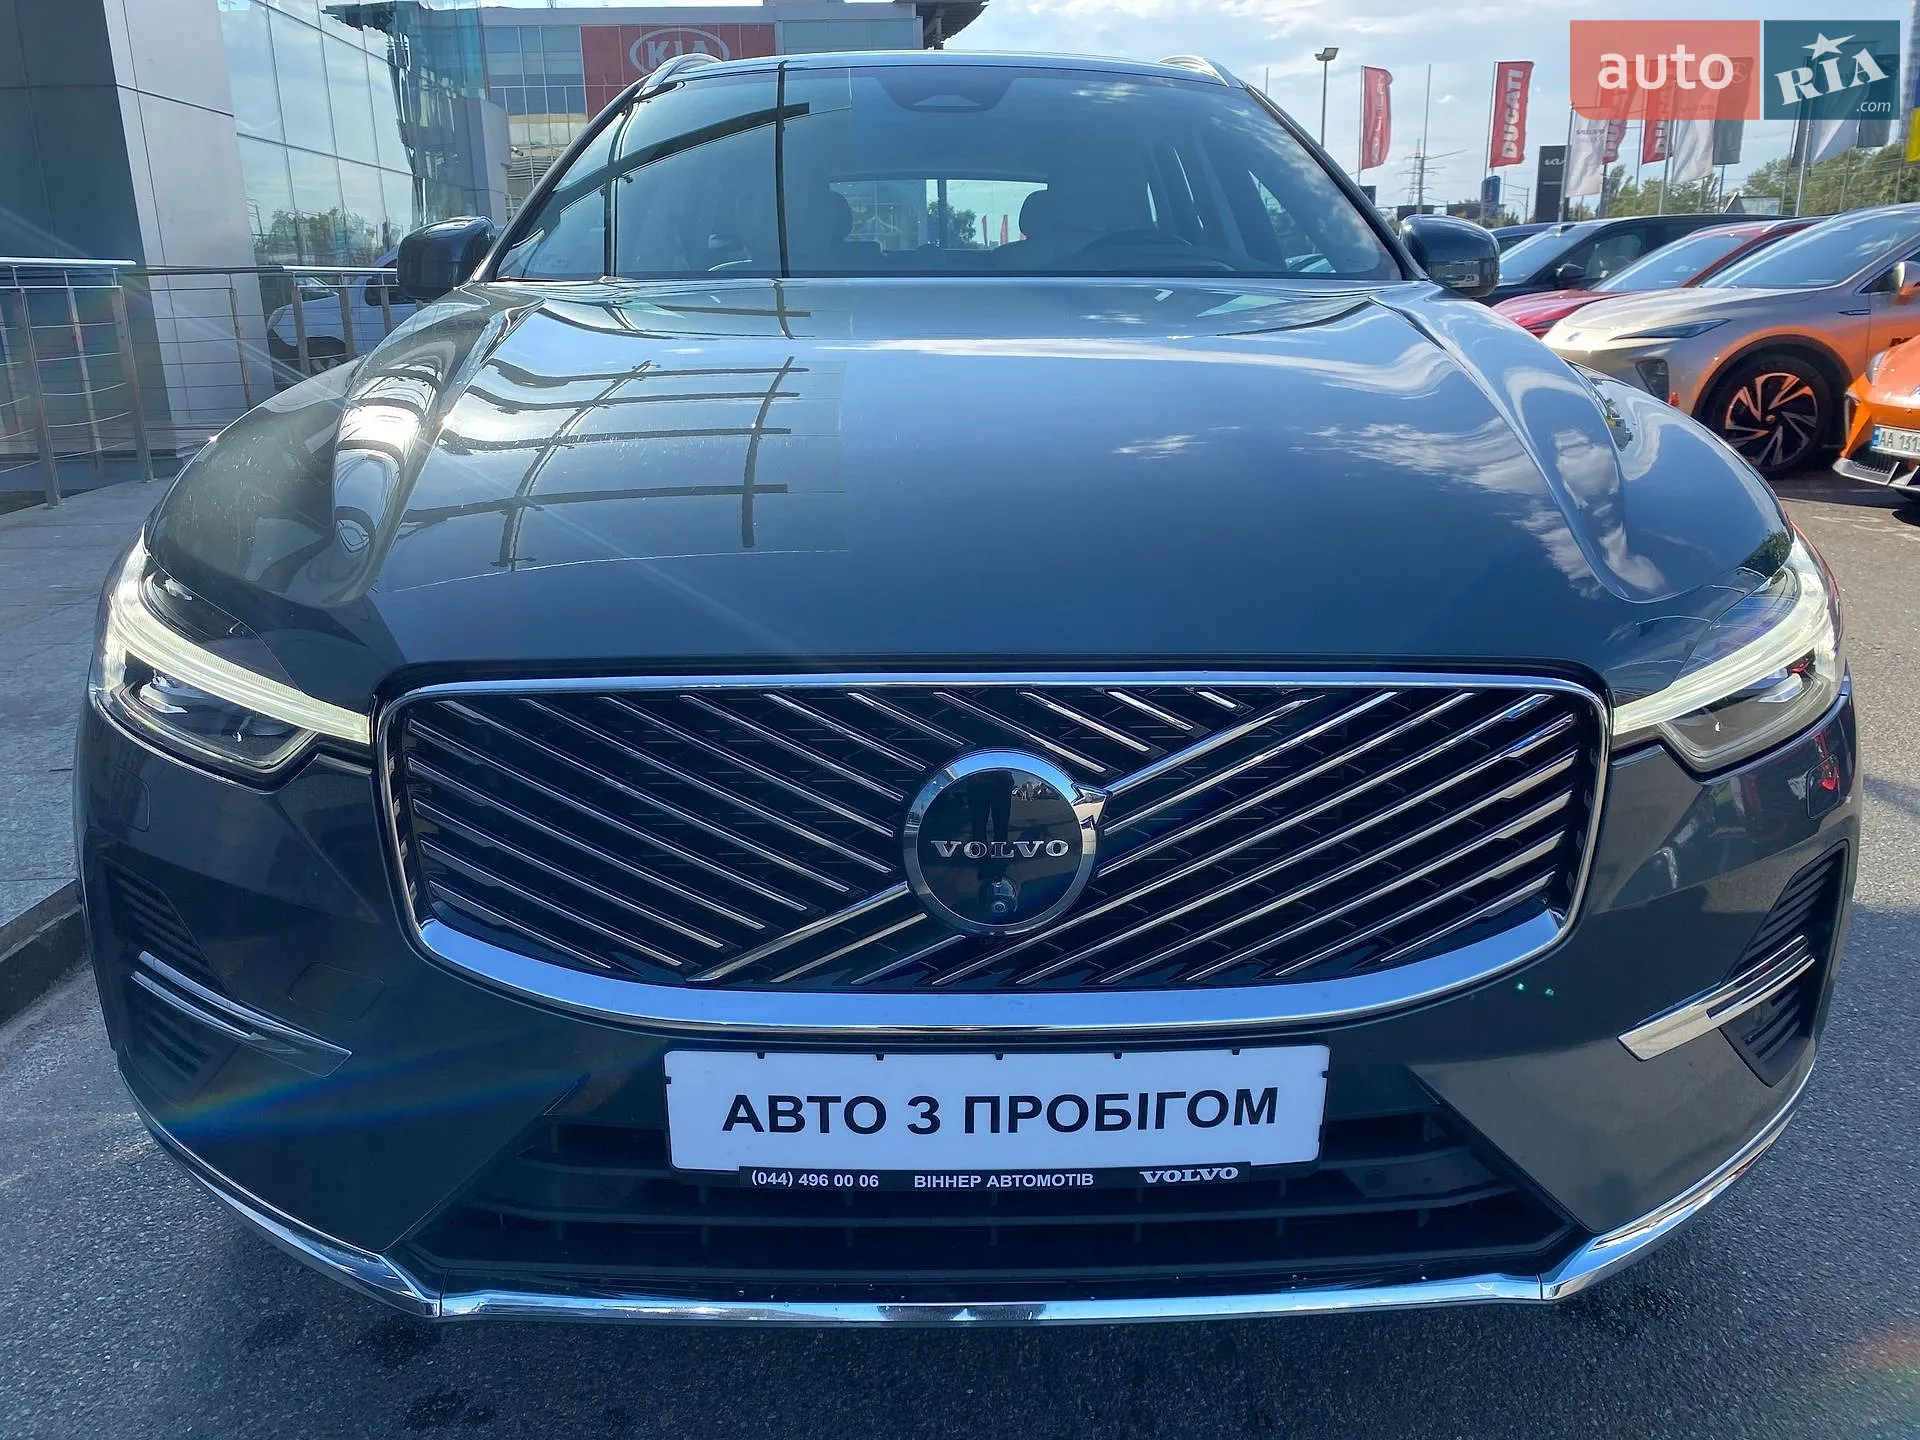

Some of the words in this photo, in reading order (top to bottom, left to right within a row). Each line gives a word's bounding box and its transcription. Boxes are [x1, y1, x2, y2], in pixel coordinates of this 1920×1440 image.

[1502, 69, 1523, 158] DUCATI
[931, 840, 1069, 859] VOLVO
[722, 1094, 887, 1135] АВТО
[964, 1087, 1278, 1134] ПРОБІГОМ
[751, 1169, 794, 1187] (044)
[799, 1173, 829, 1187] 496
[834, 1174, 854, 1187] 00
[859, 1174, 879, 1188] 06
[914, 1175, 982, 1188] ВІННЕР
[987, 1173, 1095, 1188] АВТОМОТІВ
[1139, 1166, 1239, 1184] VOLVO
